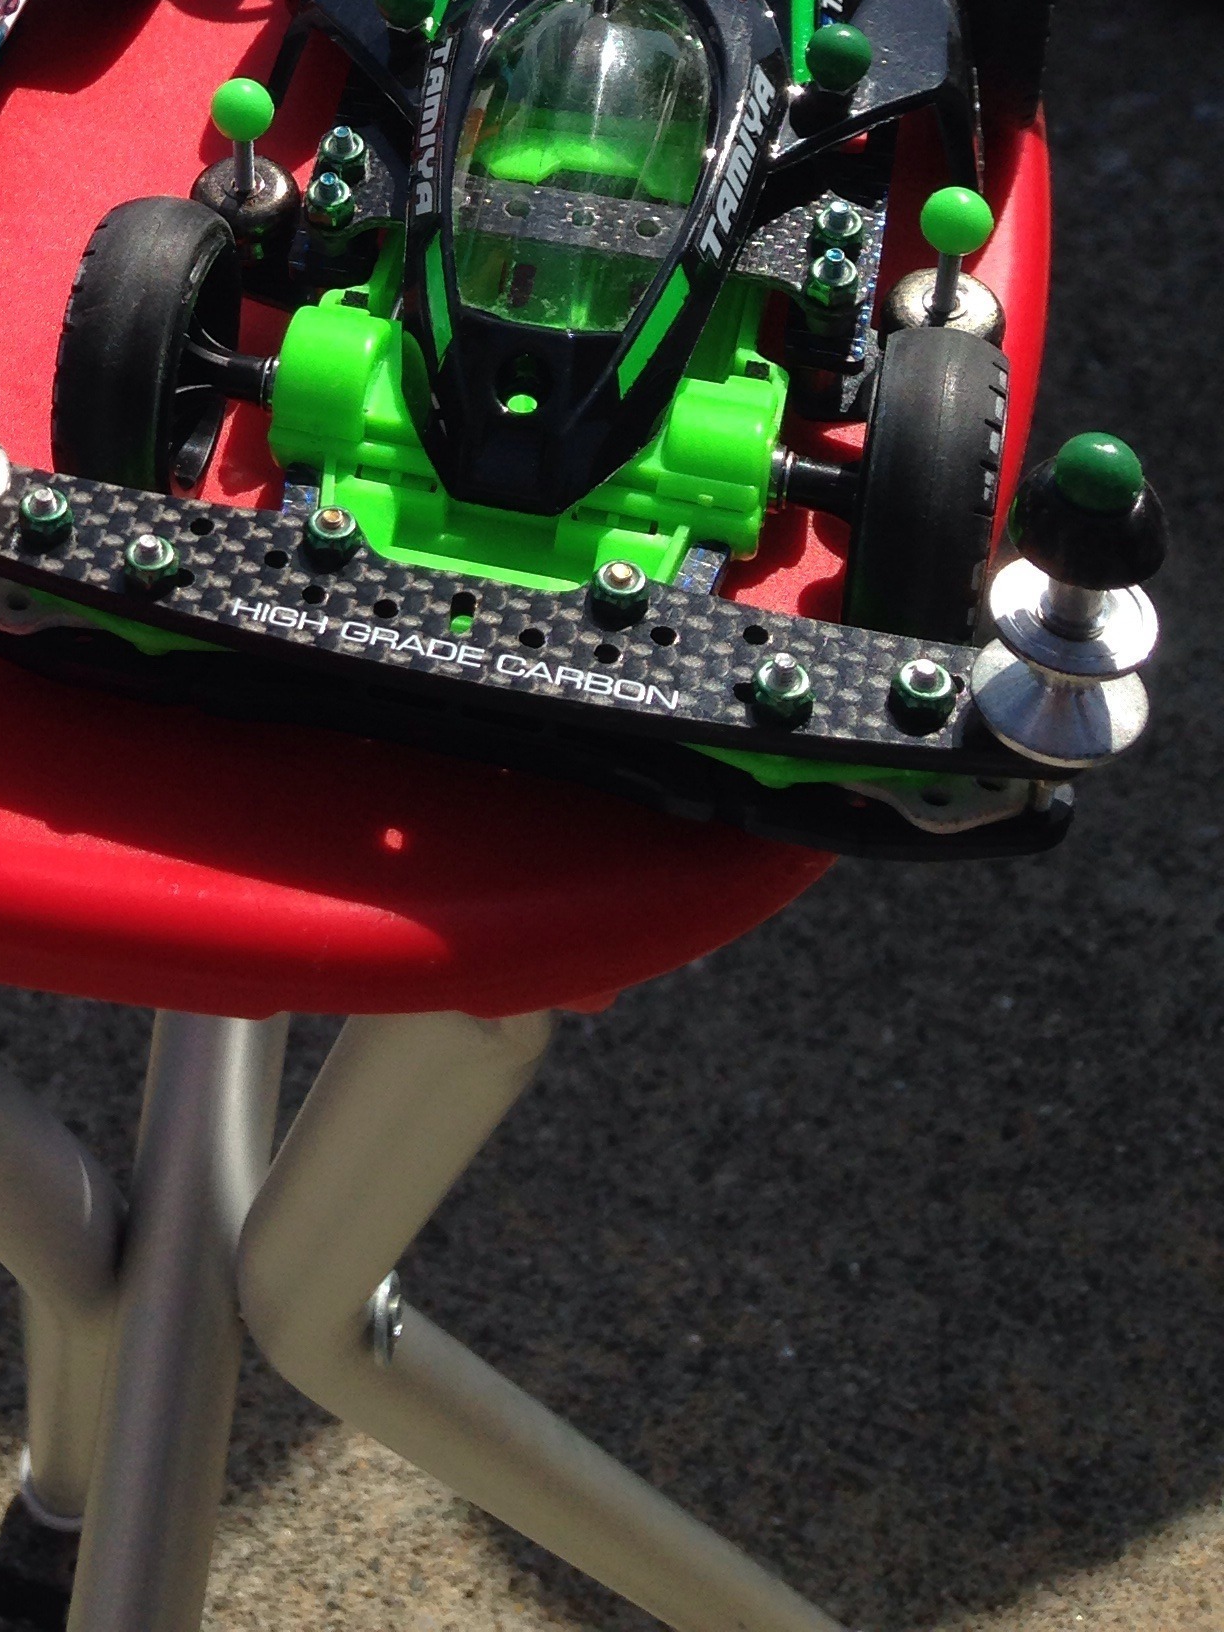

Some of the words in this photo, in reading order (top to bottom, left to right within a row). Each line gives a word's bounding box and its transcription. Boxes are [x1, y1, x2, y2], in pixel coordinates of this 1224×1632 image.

[415, 37, 453, 216] TAMIYA
[699, 64, 775, 259] TAMIYA
[230, 598, 329, 635] HIGH
[339, 620, 485, 668] GRADE
[496, 653, 680, 710] CARBON
